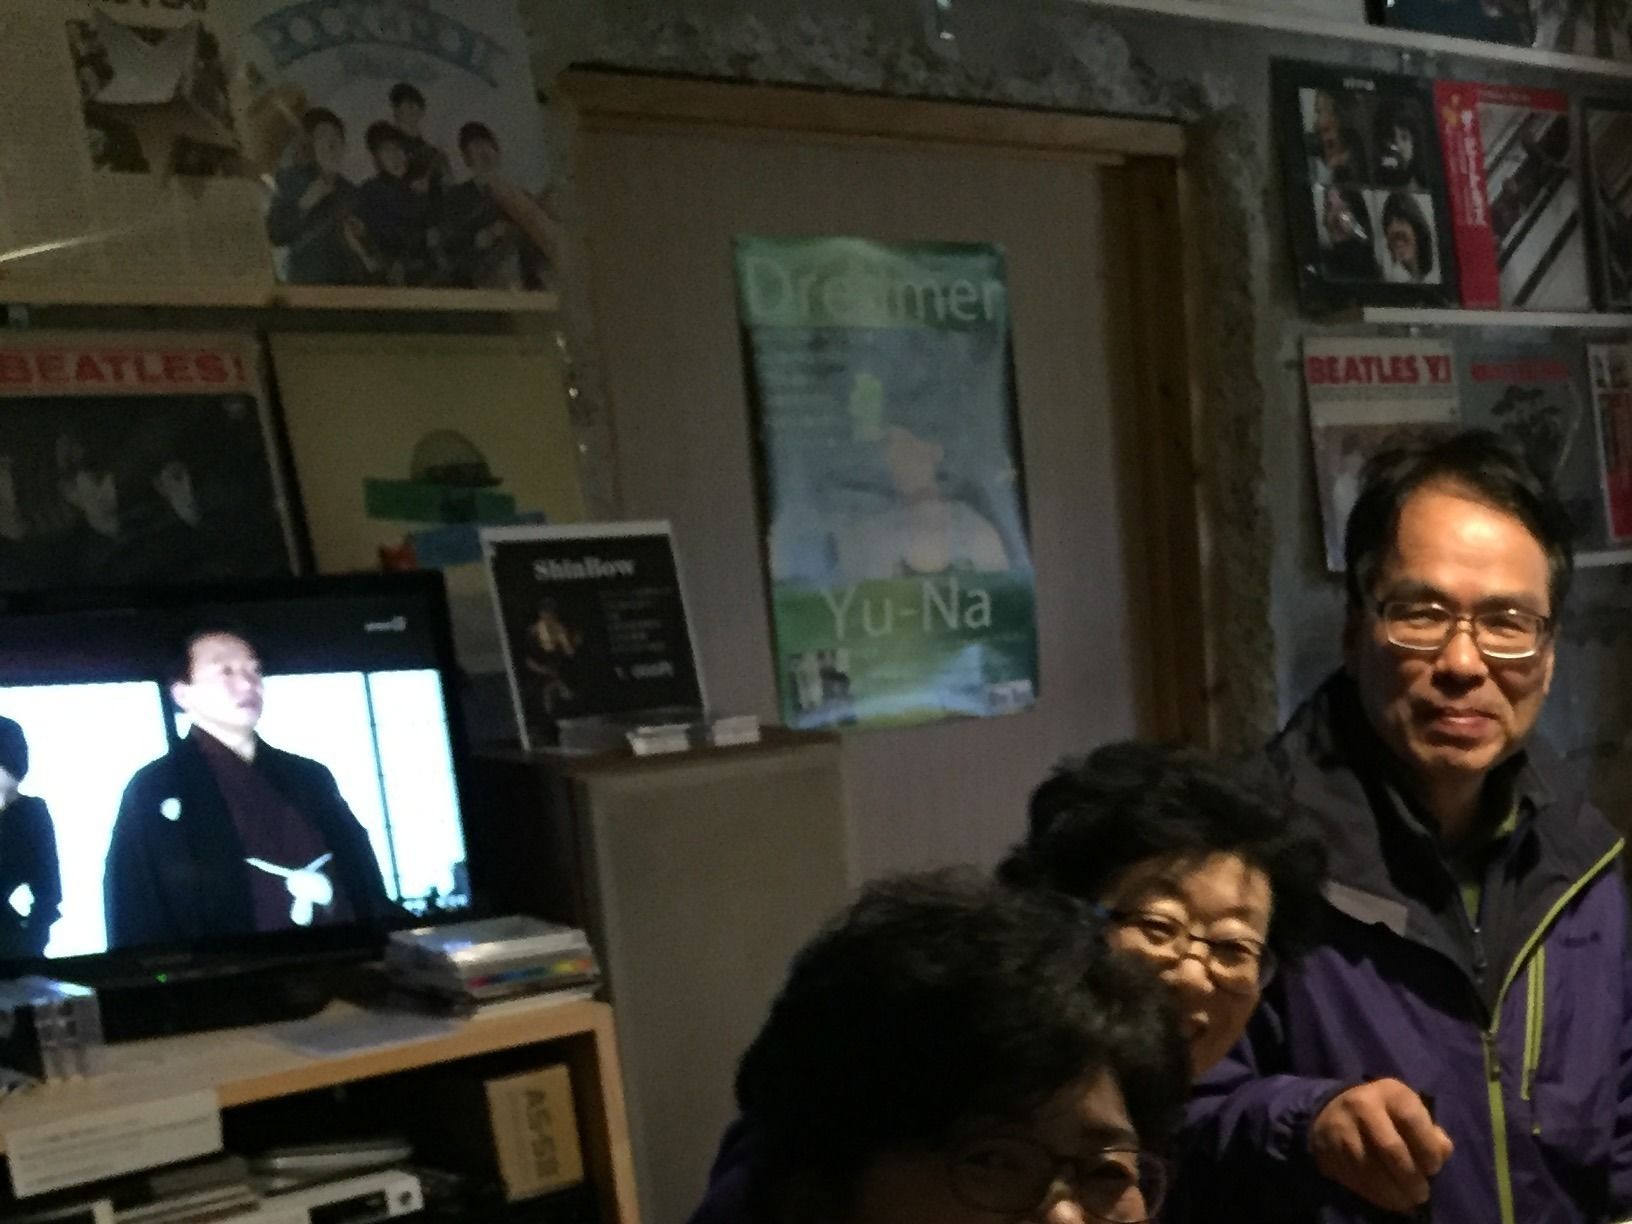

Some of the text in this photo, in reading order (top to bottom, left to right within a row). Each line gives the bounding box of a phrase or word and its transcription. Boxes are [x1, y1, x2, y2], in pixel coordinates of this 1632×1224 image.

[744, 256, 1006, 322] Dremer
[1306, 355, 1419, 384] BEATLES
[820, 576, 992, 641] Yu-Na
